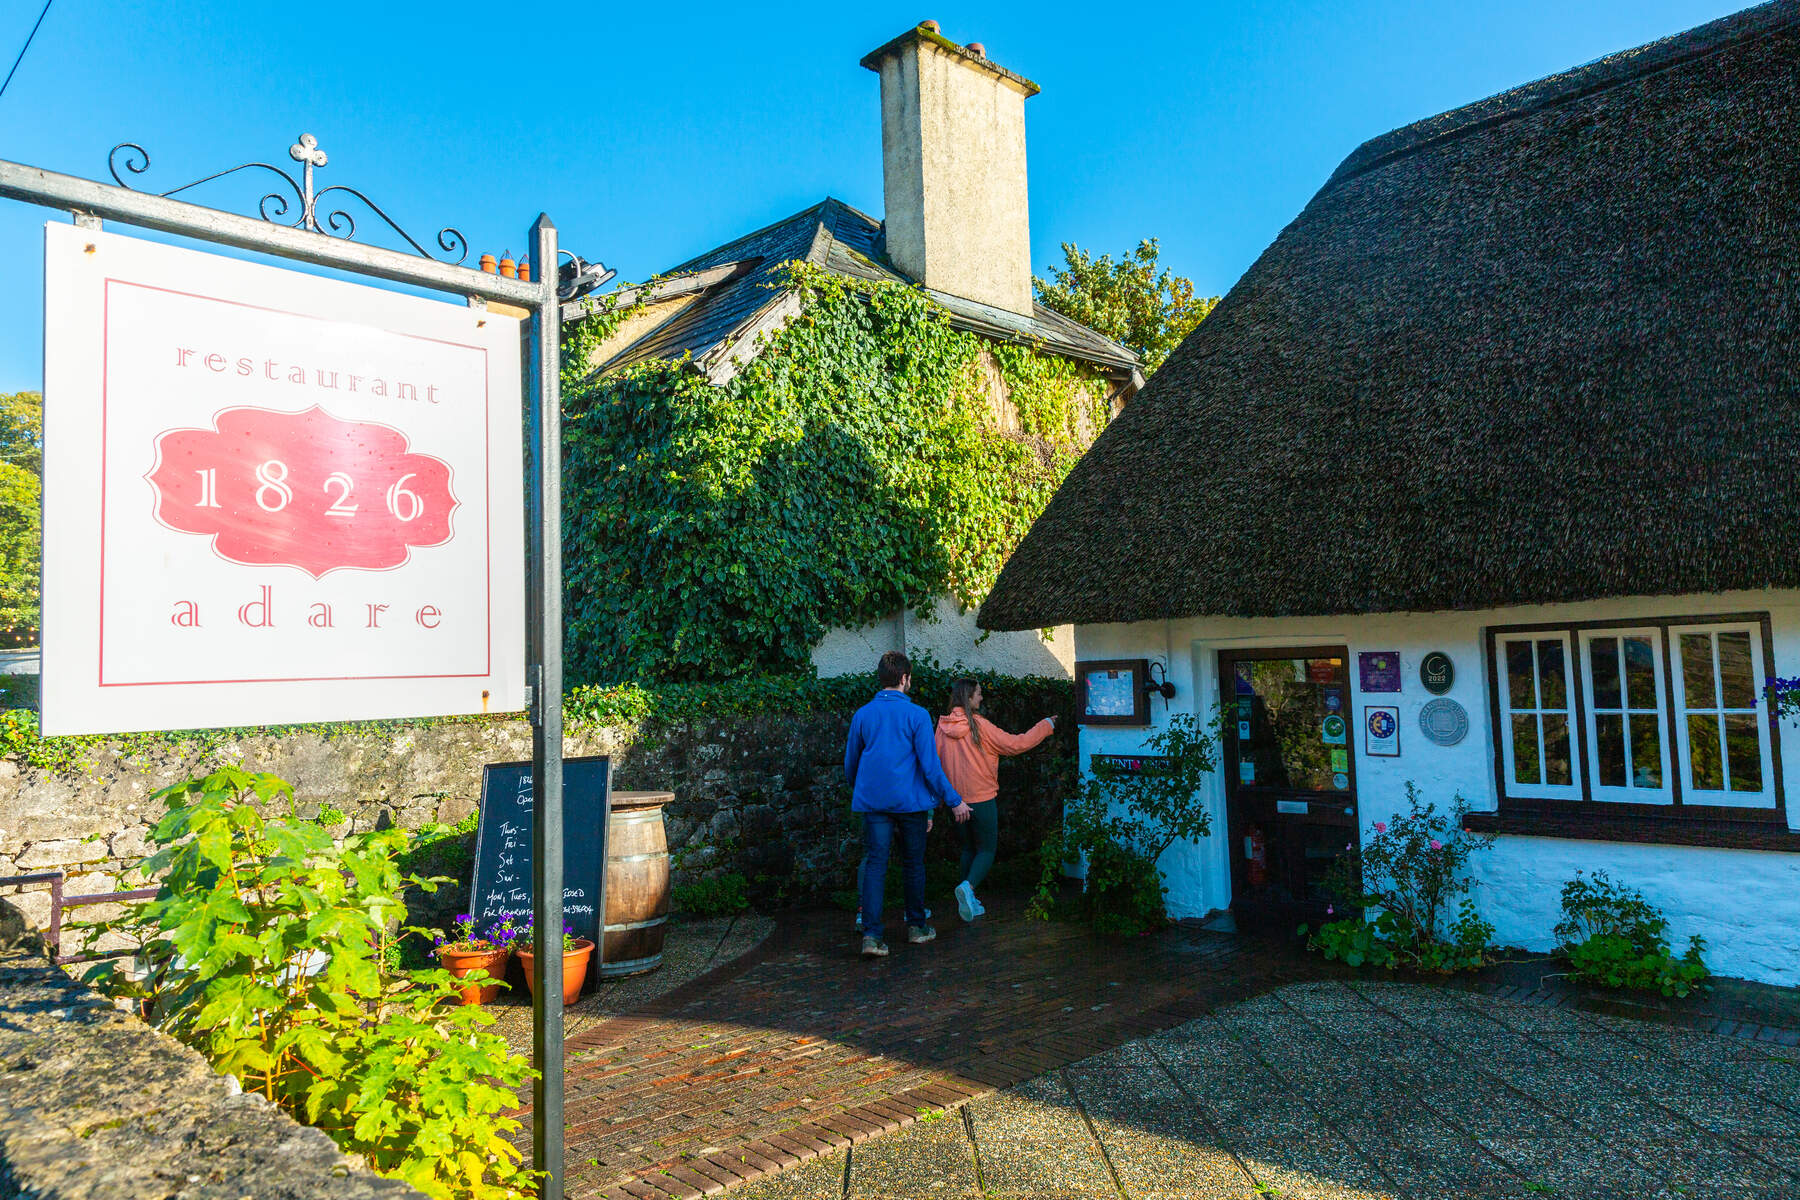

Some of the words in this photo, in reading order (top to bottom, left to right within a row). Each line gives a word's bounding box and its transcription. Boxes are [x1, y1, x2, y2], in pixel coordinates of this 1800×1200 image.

[176, 347, 440, 404] restaurant
[194, 460, 424, 522] 1826
[171, 585, 442, 629] adare
